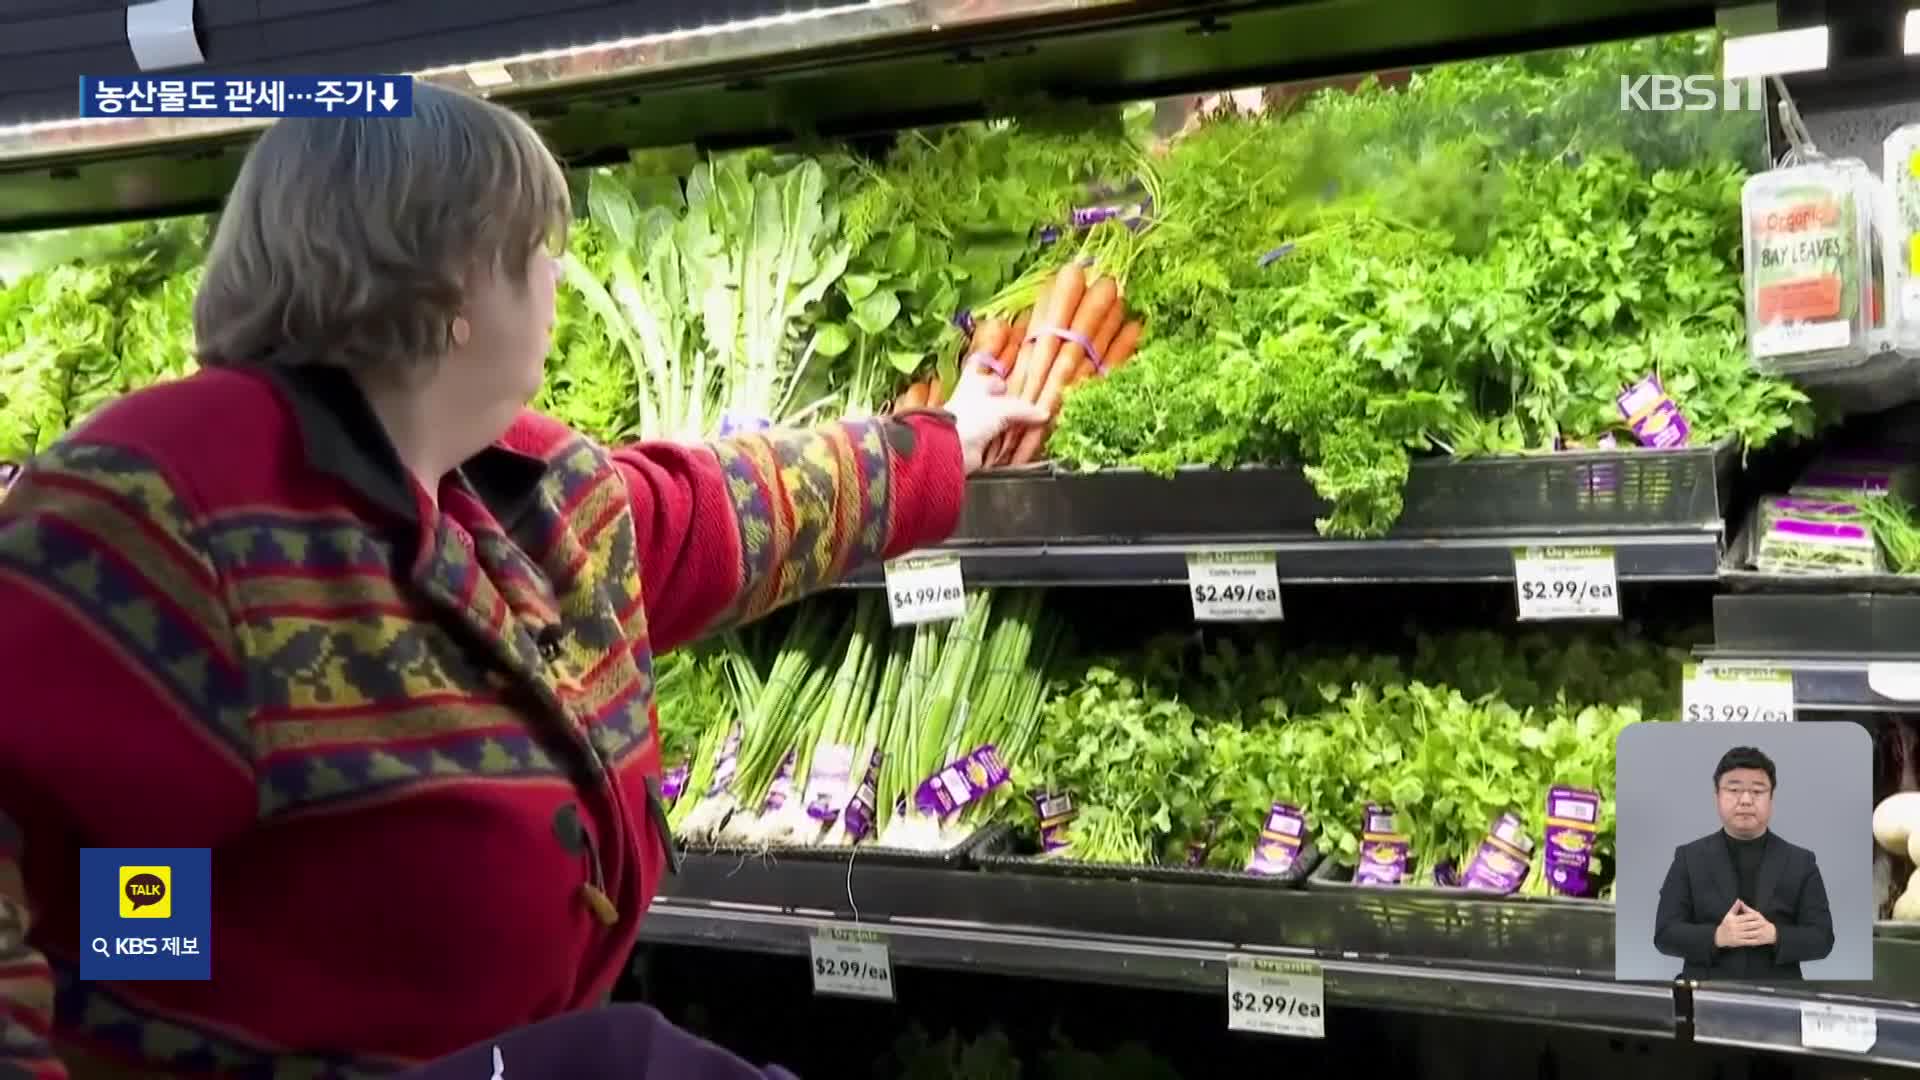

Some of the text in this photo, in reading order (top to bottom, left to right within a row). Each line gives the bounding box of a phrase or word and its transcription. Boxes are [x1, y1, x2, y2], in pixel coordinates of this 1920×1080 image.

[1761, 238, 1841, 268] BAY LEAVES
[1195, 584, 1277, 603] $2.49/ea
[1522, 581, 1613, 601] $2.99/ea
[1687, 703, 1788, 722] $399/ea
[815, 957, 888, 981] $2.99/ea
[1232, 991, 1321, 1018] $2.99/ea
